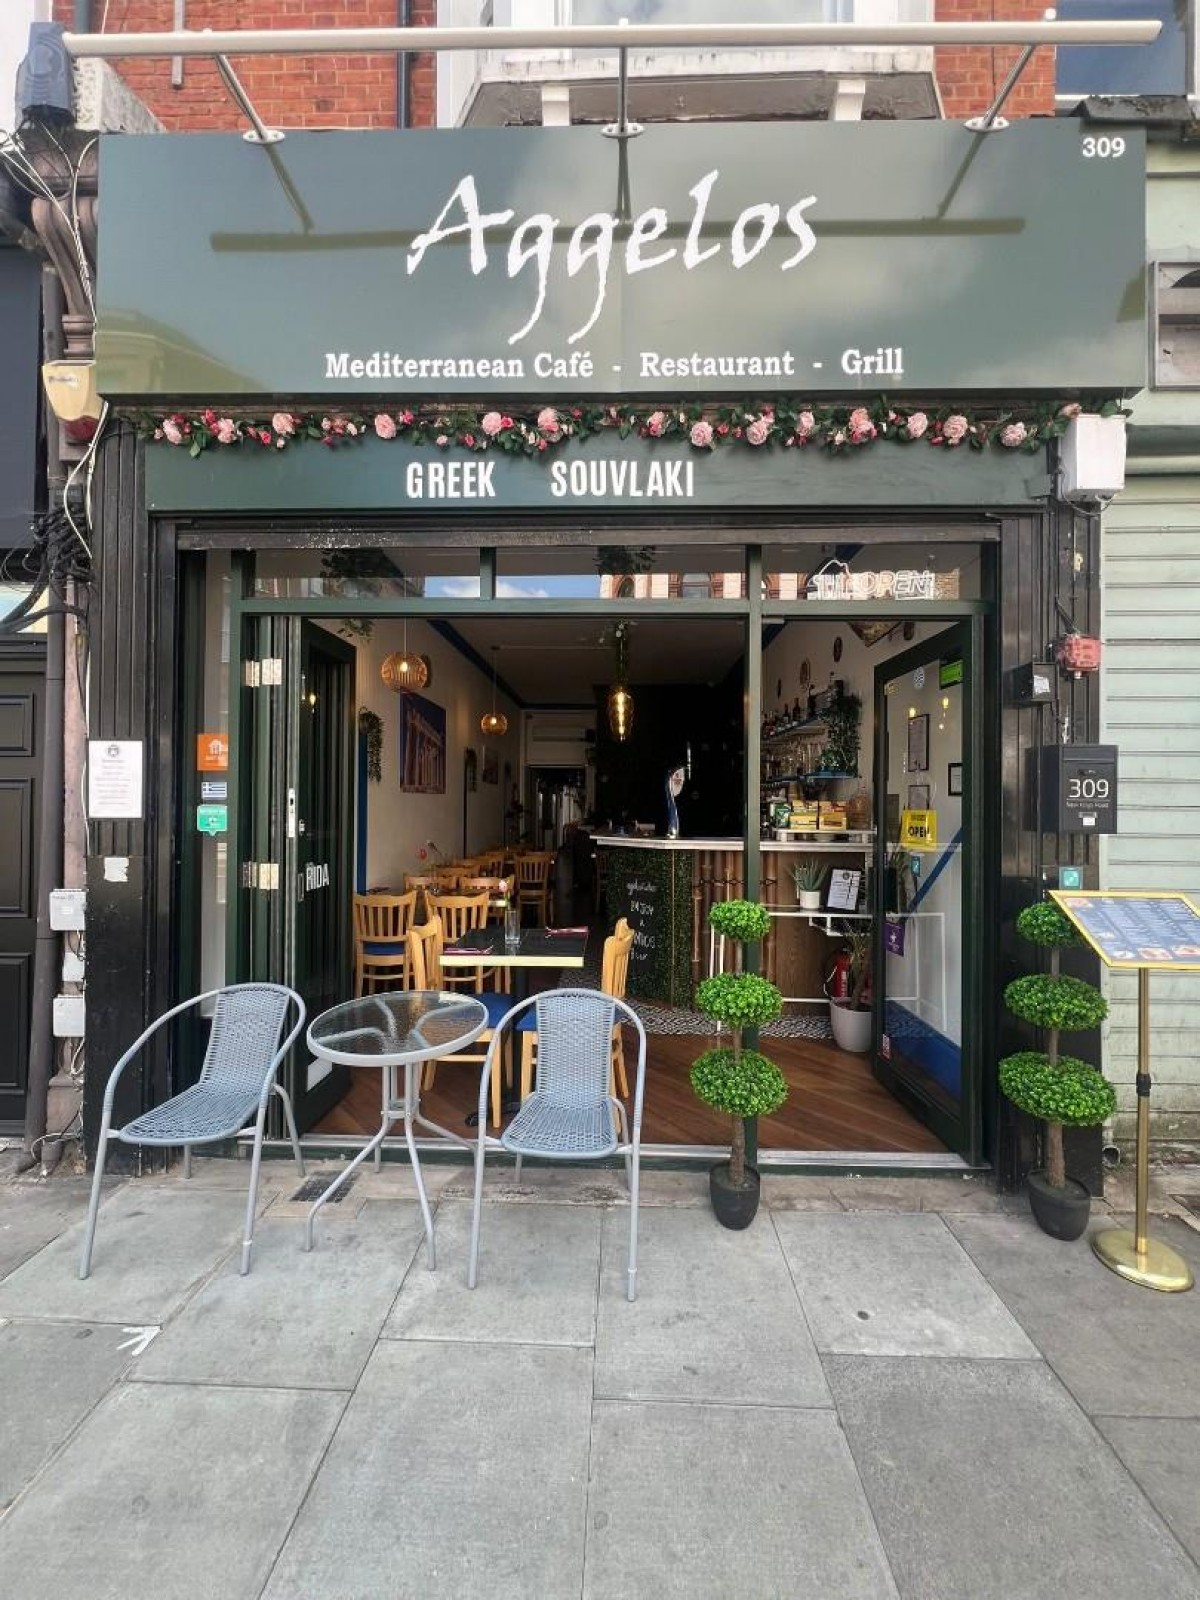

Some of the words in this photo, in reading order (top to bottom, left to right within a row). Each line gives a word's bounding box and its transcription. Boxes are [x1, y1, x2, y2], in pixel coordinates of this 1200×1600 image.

[1082, 137, 1125, 158] 309
[407, 169, 818, 345] Aggelos
[325, 352, 524, 379] Mediterranean
[534, 351, 594, 379] Café
[640, 351, 795, 377] Restaurant
[841, 348, 904, 375] Grill
[406, 461, 496, 498] GREEK
[551, 460, 694, 497] SOUVLAKI
[1068, 778, 1109, 798] 309
[908, 826, 930, 838] OPEN
